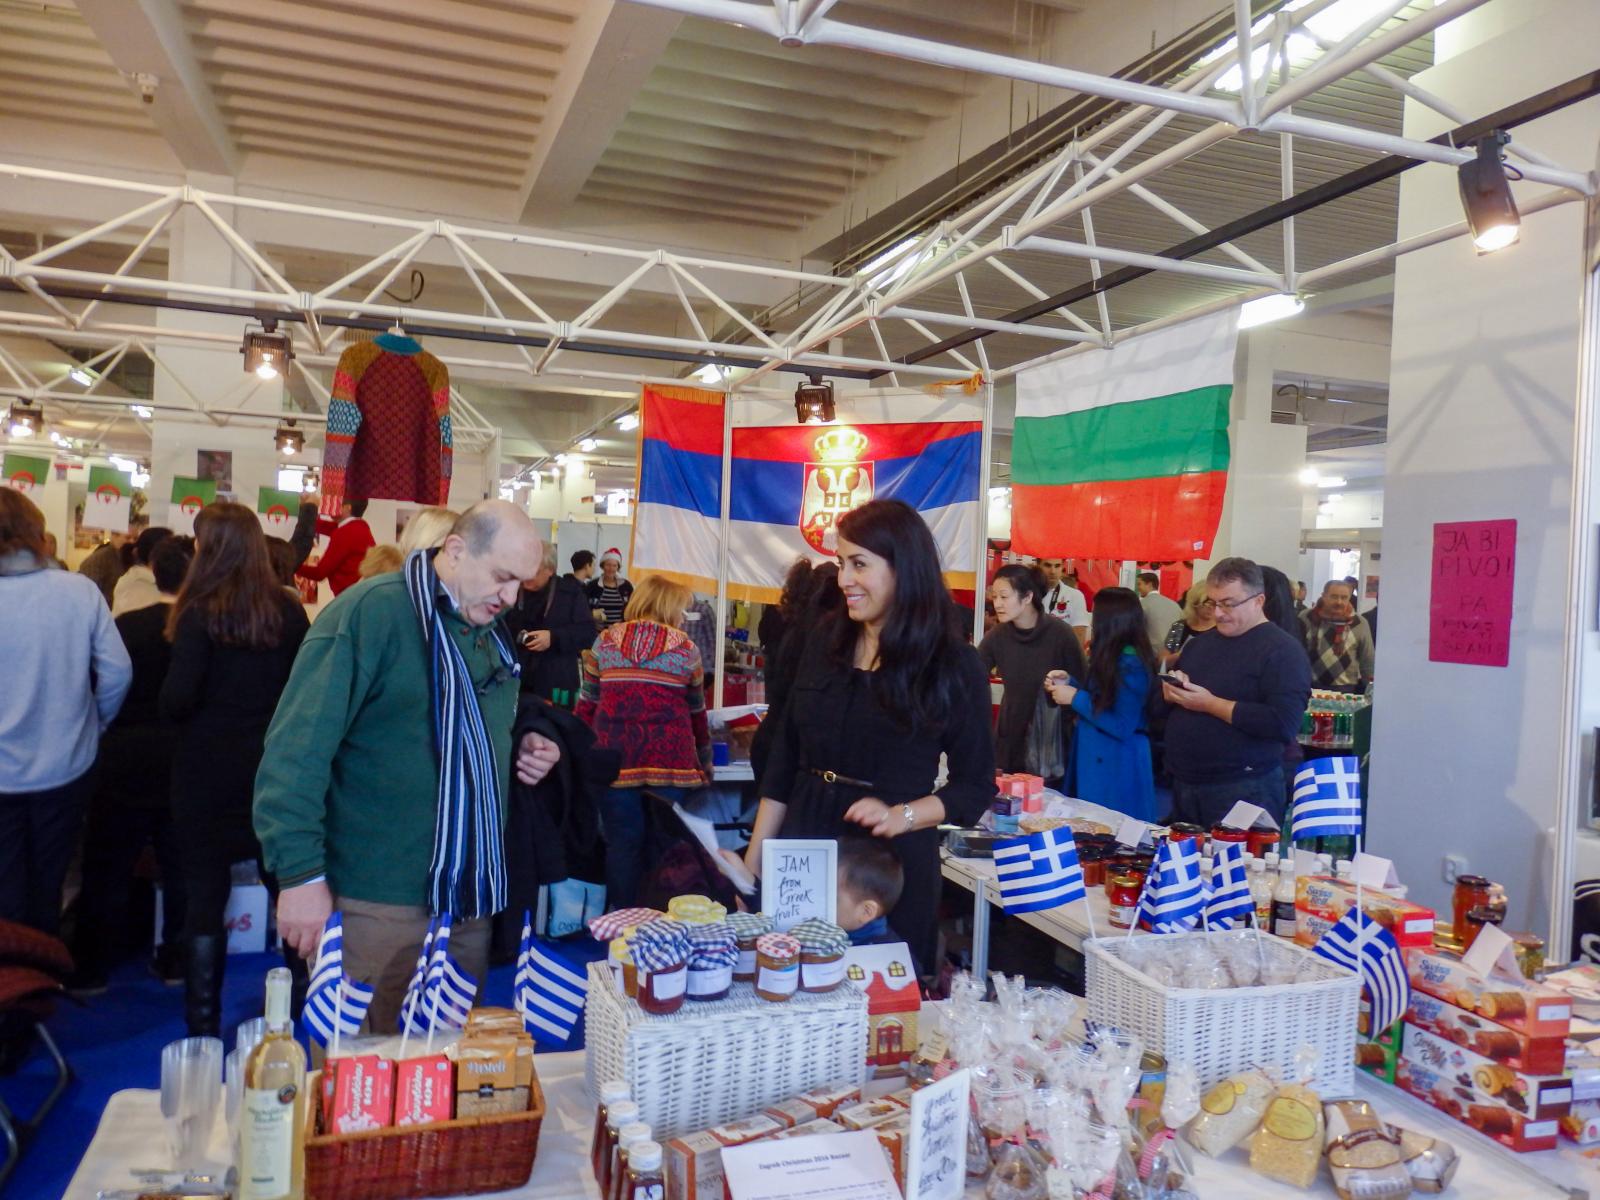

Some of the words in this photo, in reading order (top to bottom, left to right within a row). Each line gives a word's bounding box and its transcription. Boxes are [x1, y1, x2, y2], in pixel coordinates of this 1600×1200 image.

[1441, 529, 1470, 553] JA
[1480, 528, 1499, 552] BI
[777, 854, 811, 873] JAM
[778, 876, 801, 898] from
[780, 888, 814, 906] Greek
[775, 904, 800, 926] fruits
[782, 1156, 813, 1168] Christmas
